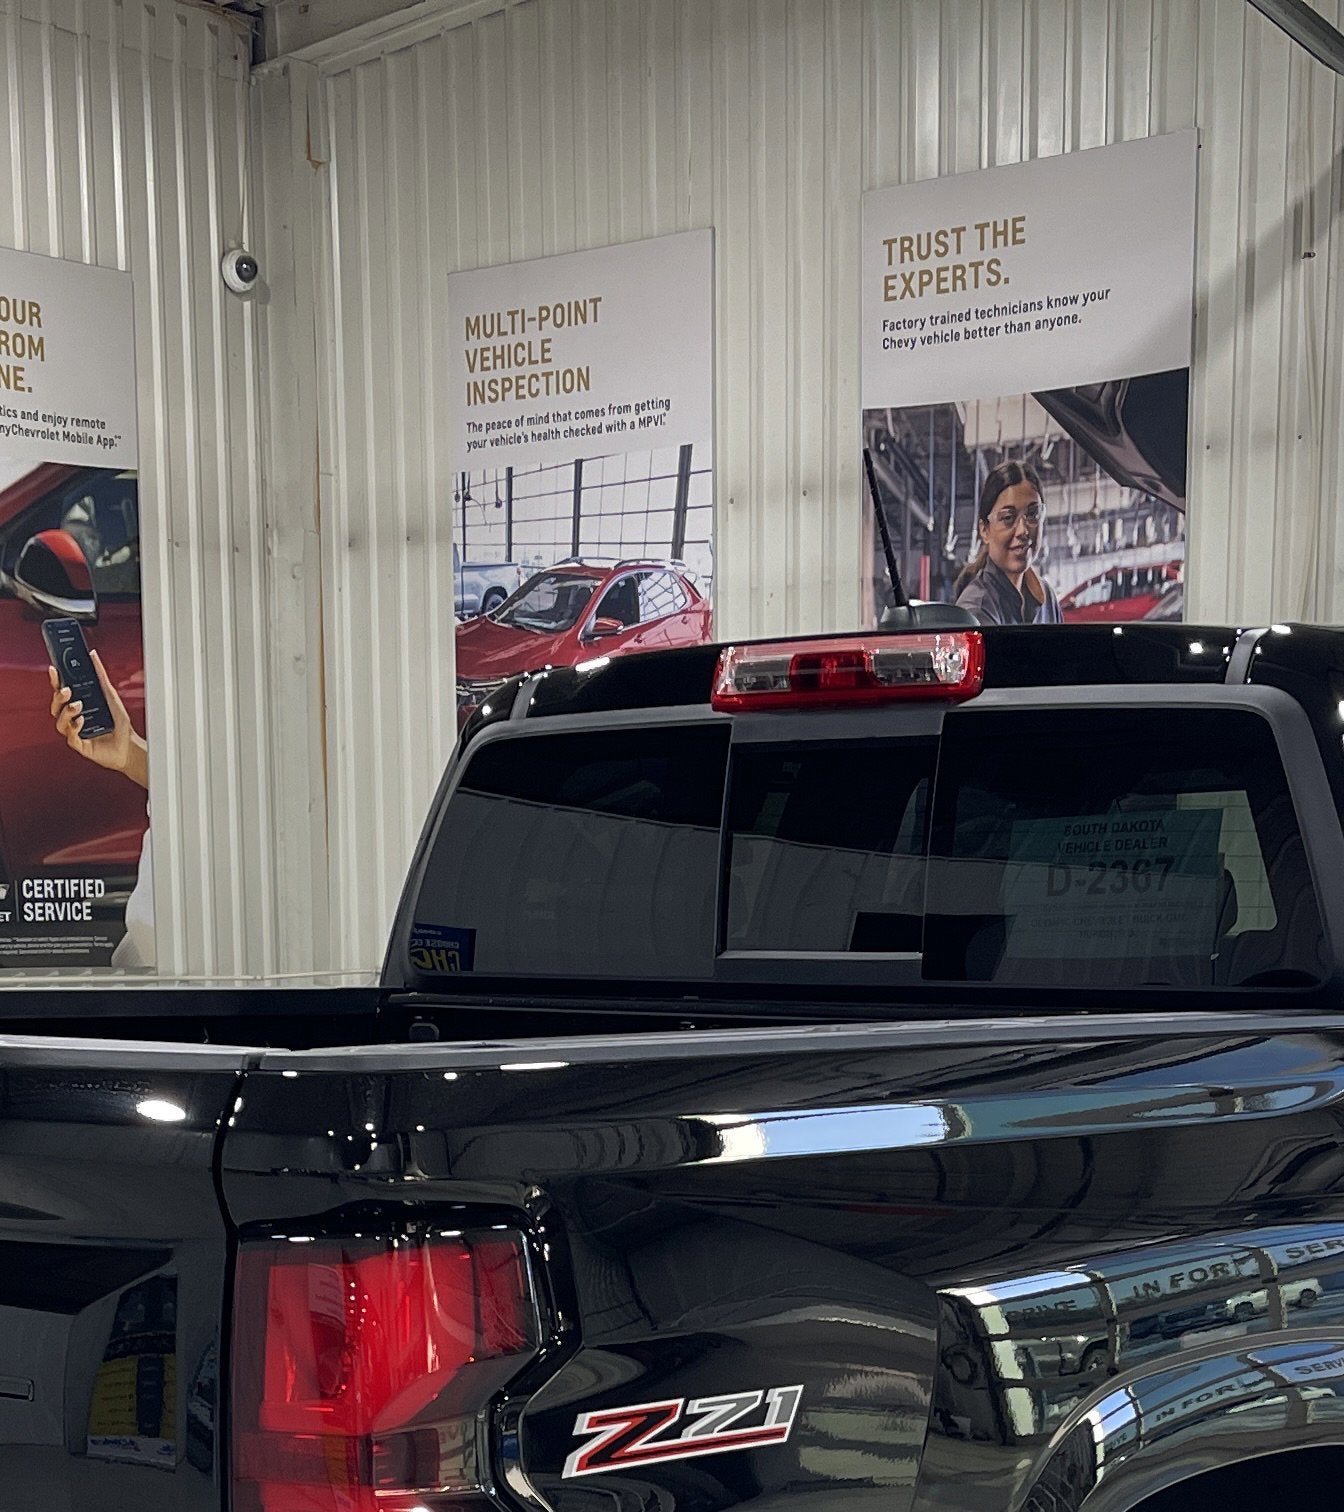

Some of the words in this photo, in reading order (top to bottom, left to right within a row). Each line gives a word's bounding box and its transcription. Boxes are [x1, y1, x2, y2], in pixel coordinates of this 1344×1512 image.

[882, 225, 966, 266] TRUST
[974, 215, 1026, 251] THE
[883, 257, 1010, 302] EXPERTS.
[464, 296, 602, 342] MULTI-POINT
[882, 314, 926, 333] Factory
[929, 307, 971, 326] trained
[974, 300, 1044, 321] technicians
[1046, 294, 1080, 311] know
[1081, 288, 1111, 306] your
[882, 333, 917, 350] Chevy
[919, 329, 961, 346] vehicle
[963, 323, 1002, 341] better
[1004, 319, 1031, 335] than
[1034, 312, 1082, 331] anyone.
[464, 337, 553, 374] VEHICLE
[466, 365, 591, 407] INSPECTION
[20, 409, 39, 422] and
[41, 412, 68, 428] enjoy
[70, 417, 106, 430] remote
[466, 421, 483, 434] The
[485, 417, 513, 432] peace
[514, 414, 525, 428] of
[526, 411, 550, 427] mind
[552, 410, 572, 424] that
[574, 407, 605, 421] comes
[608, 402, 632, 415] from
[634, 397, 671, 415] getting
[62, 430, 94, 445] Mobile
[466, 439, 487, 453] your
[489, 430, 529, 447] vehicle's
[531, 427, 561, 443] health
[563, 421, 603, 438] checked
[605, 418, 627, 434] with
[629, 421, 636, 430] a
[1114, 836, 1169, 851] DEALER
[21, 878, 105, 899] CERTIFIED
[23, 901, 93, 922] SERVICE
[1168, 1262, 1230, 1289] FOR
